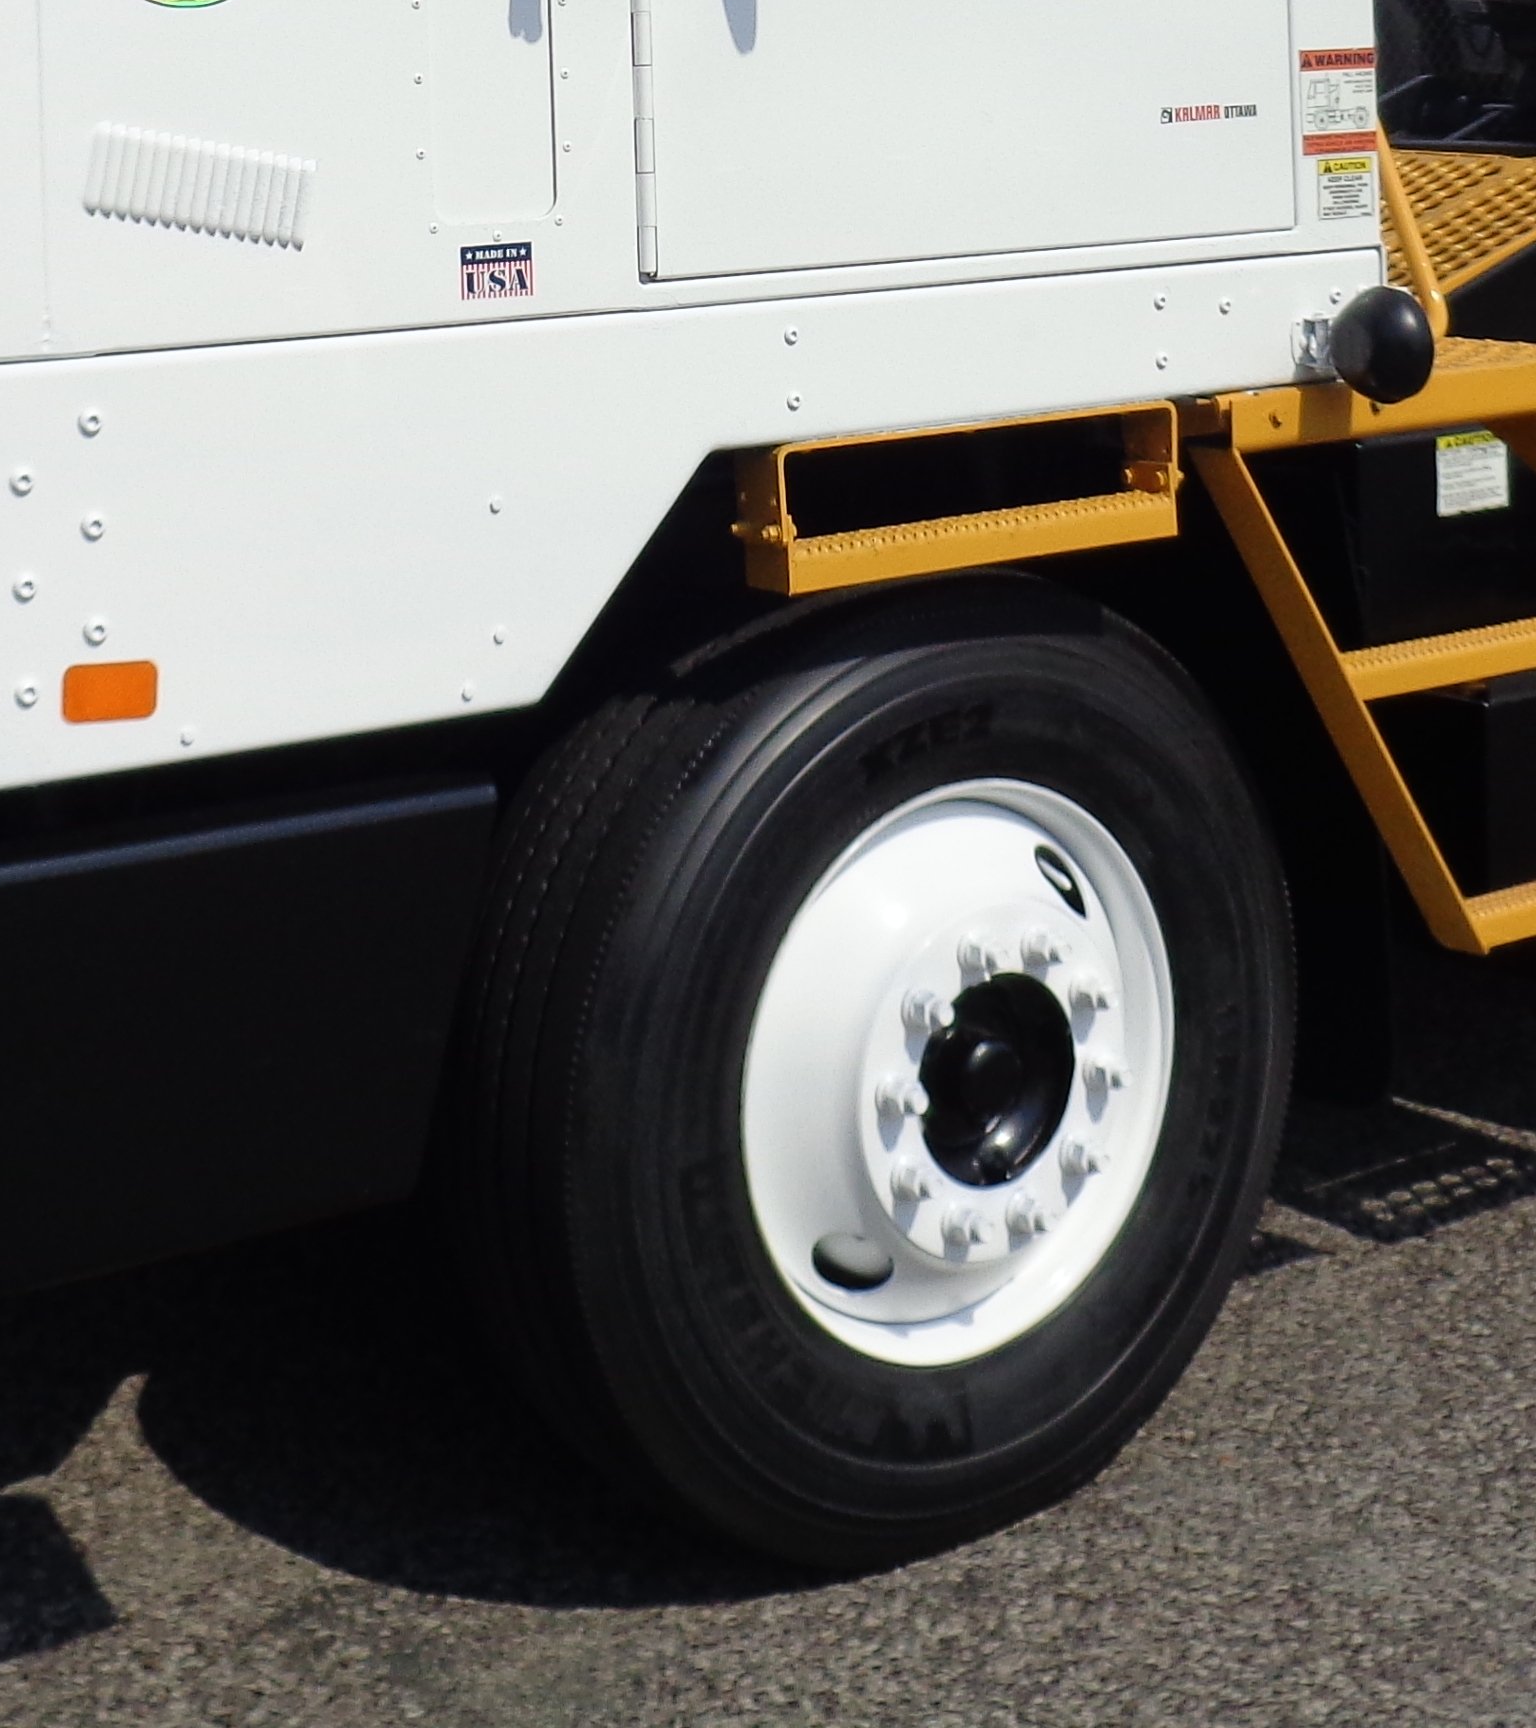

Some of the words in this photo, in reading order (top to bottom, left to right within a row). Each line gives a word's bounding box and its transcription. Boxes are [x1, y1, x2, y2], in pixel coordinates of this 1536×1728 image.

[1315, 53, 1374, 67] WARNING
[1174, 105, 1221, 122] KALMAR
[1224, 105, 1257, 119] OTTAWA
[1334, 162, 1367, 171] CAUTION
[474, 250, 503, 260] MADE
[506, 248, 517, 258] IN
[465, 267, 528, 294] USA
